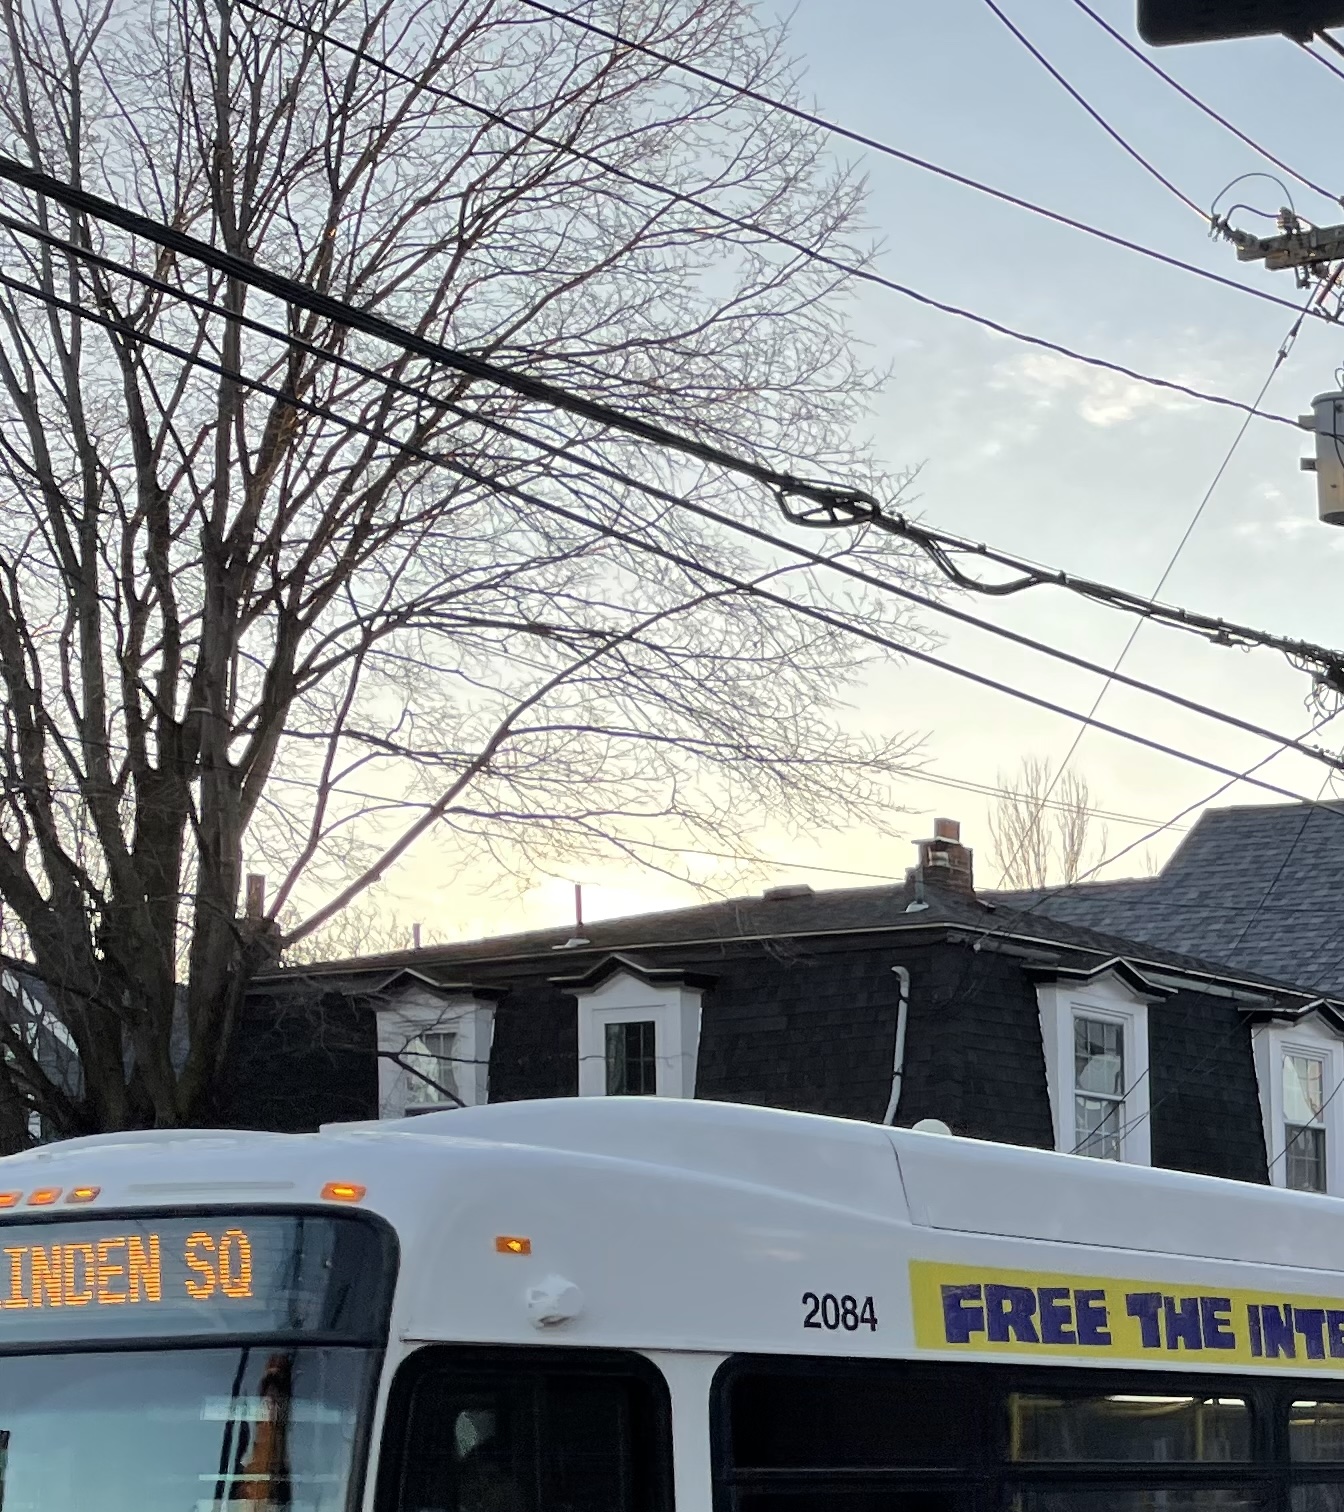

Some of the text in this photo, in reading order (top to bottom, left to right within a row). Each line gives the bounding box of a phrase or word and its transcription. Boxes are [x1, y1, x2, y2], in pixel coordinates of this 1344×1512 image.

[0, 1229, 253, 1309] INDEN SQ
[801, 1291, 878, 1333] 2084
[940, 1283, 1112, 1345] FREE
[1125, 1291, 1237, 1350] THE
